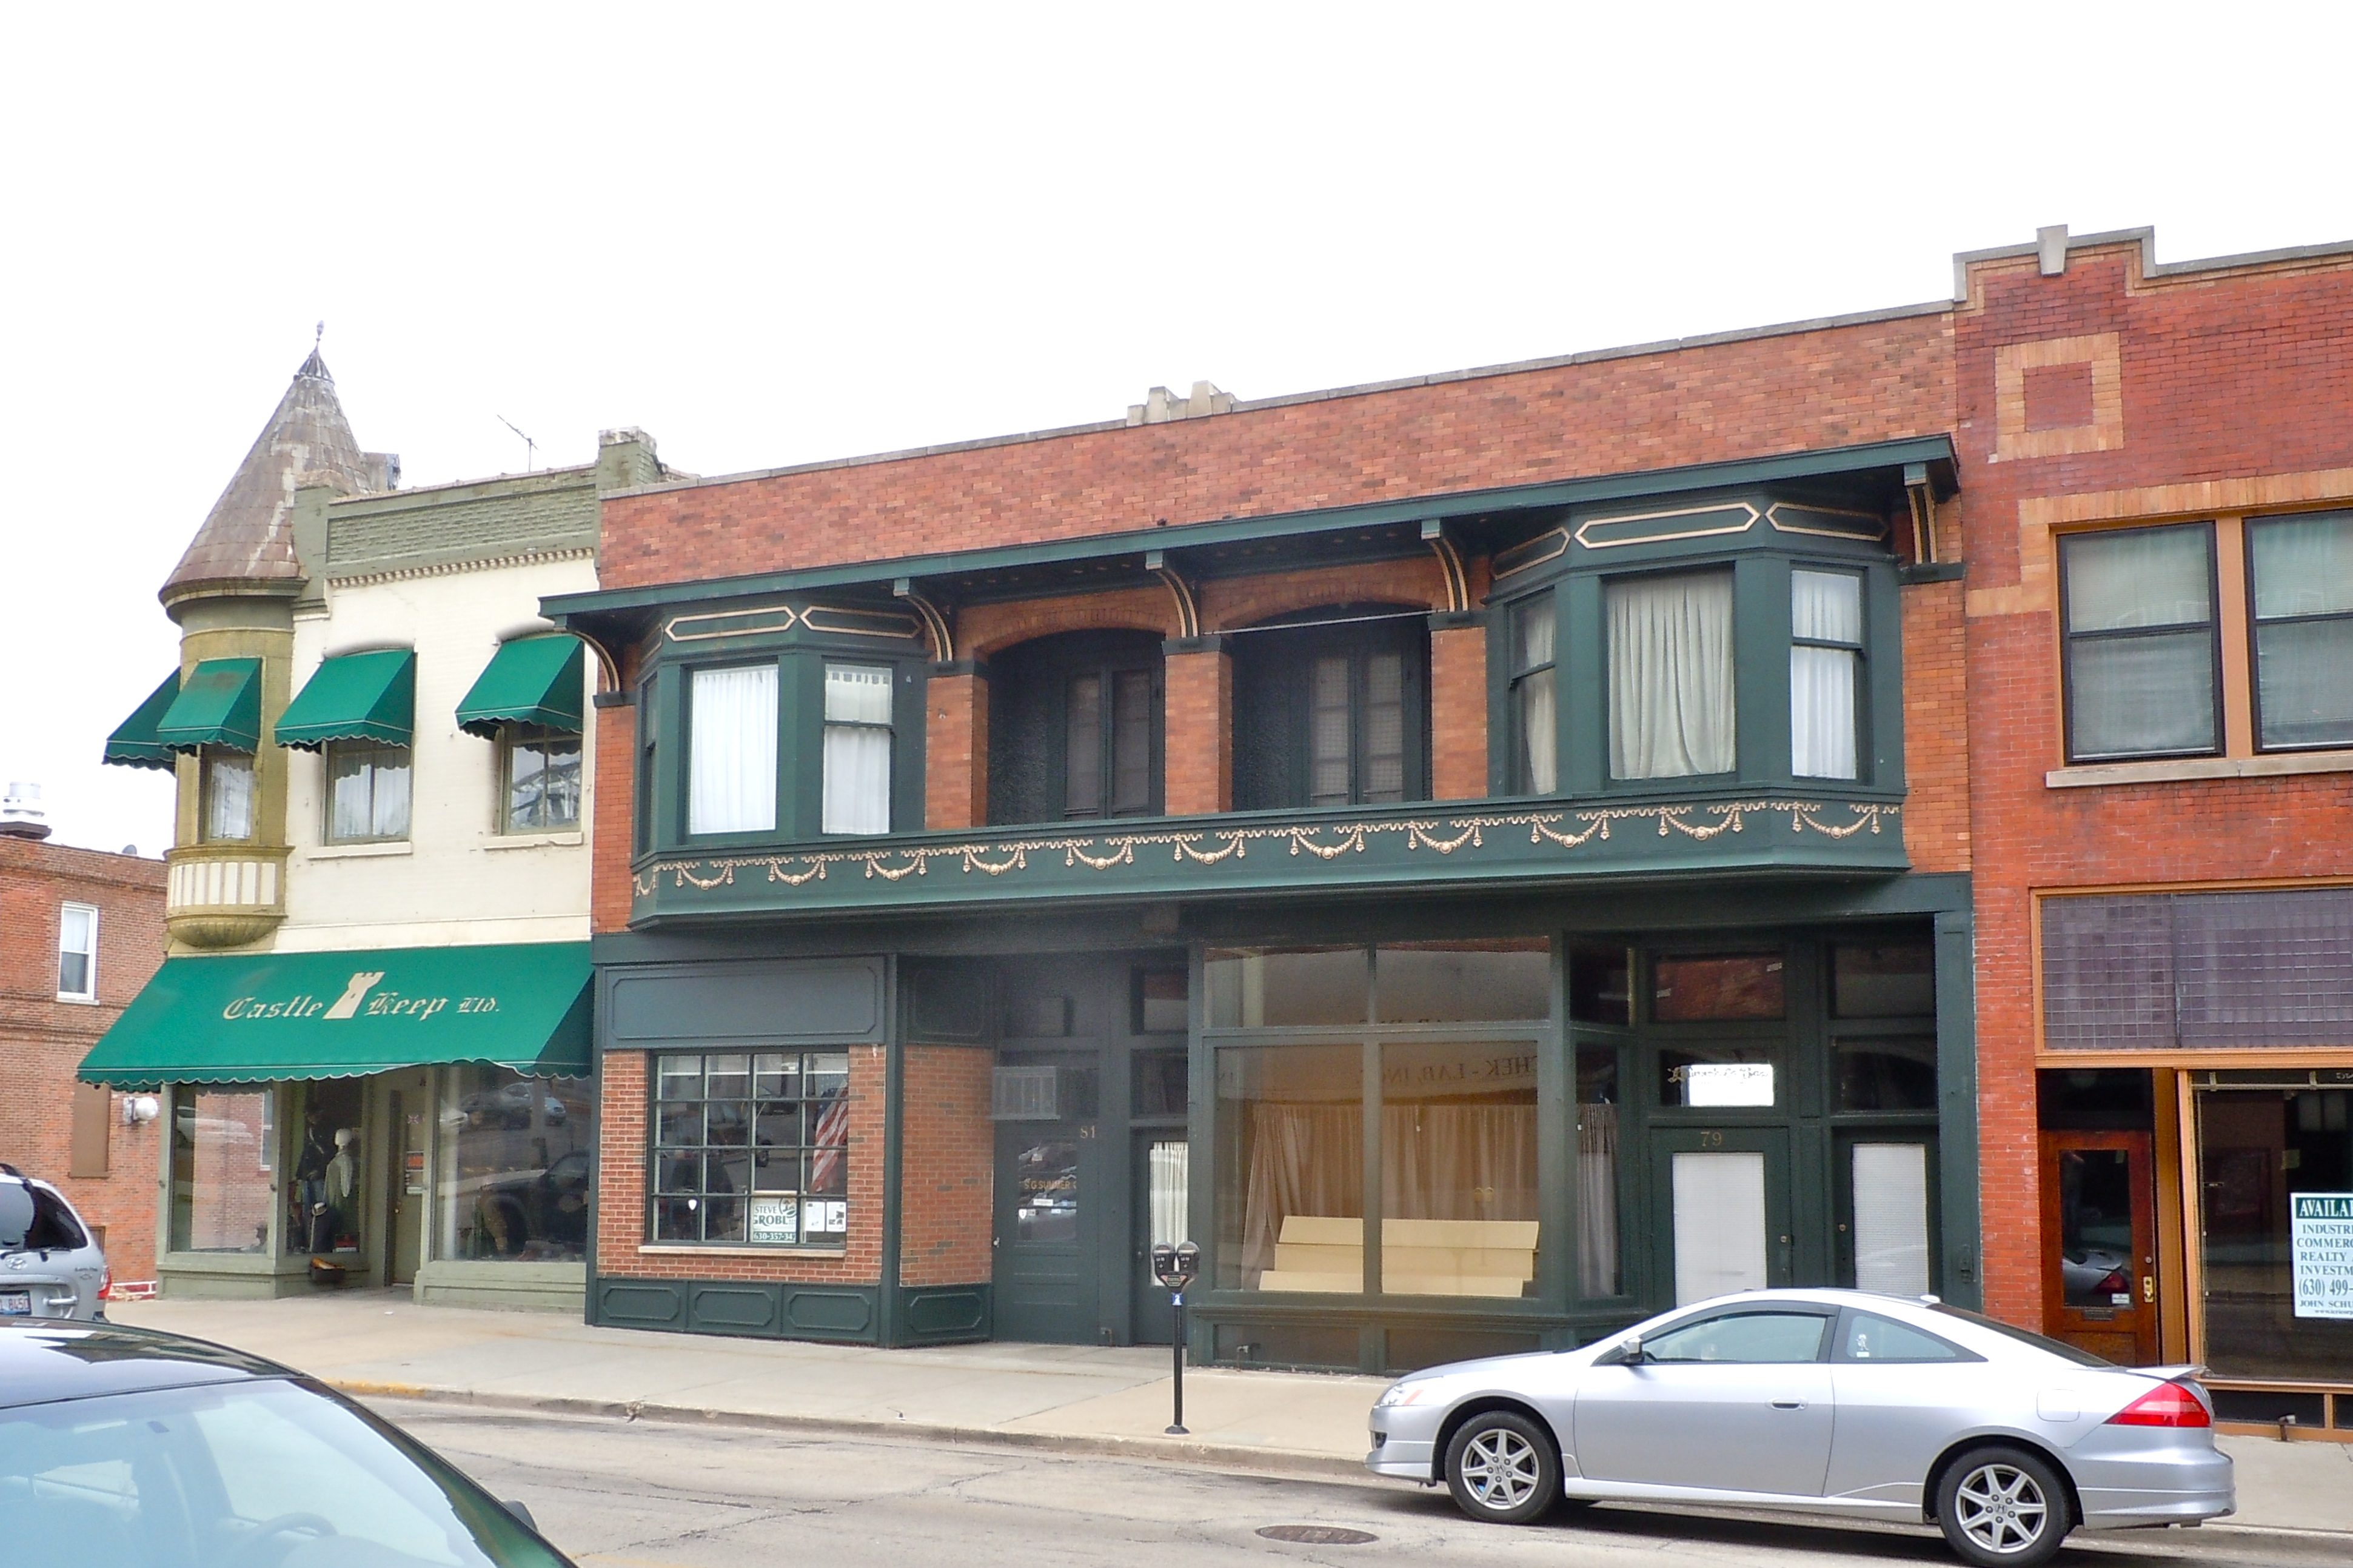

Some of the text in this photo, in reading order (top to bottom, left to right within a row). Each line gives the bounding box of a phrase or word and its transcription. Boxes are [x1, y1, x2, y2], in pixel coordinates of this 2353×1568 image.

[223, 995, 324, 1020] Castle
[364, 992, 449, 1021] Keep
[1700, 1131, 1722, 1147] 79
[755, 1206, 777, 1214] STEVE
[2299, 1199, 2353, 1217] AVAILA
[2300, 1252, 2346, 1262] REALTY
[2300, 1265, 2353, 1276] INVESTM
[2298, 1278, 2326, 1298] (630)
